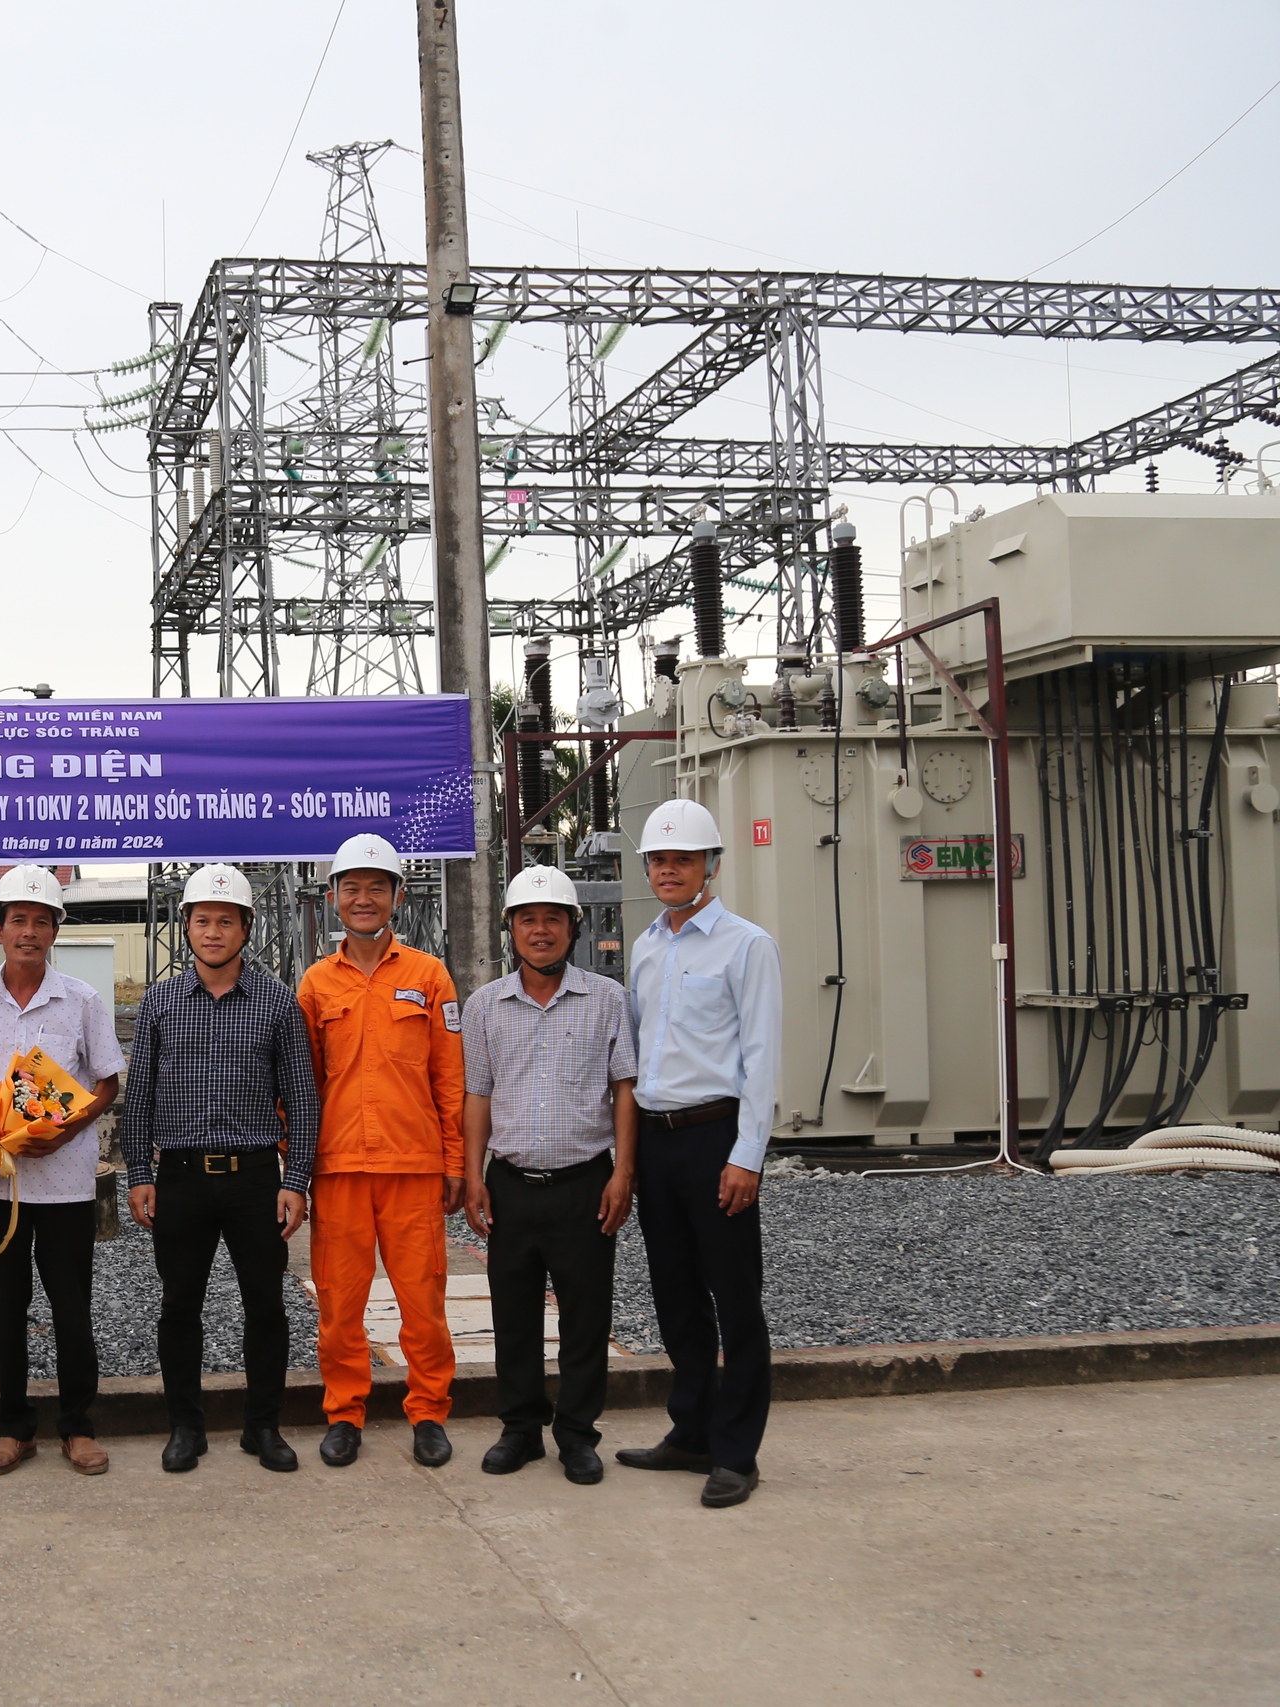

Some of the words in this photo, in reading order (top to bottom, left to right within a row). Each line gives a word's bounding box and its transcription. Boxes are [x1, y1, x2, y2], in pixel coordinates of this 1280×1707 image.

[509, 493, 525, 501] C11
[24, 710, 61, 724] LỰC
[66, 708, 115, 722] MIỀN
[120, 711, 163, 721] NAM
[35, 725, 73, 738] SÓC
[78, 725, 140, 738] TRĂNG
[50, 749, 162, 783] ĐIỆN
[14, 794, 72, 821] 110KV
[77, 794, 89, 821] 2
[94, 794, 149, 826] MẠCH
[154, 788, 191, 820] SÓC
[195, 787, 257, 820] TRĂNG
[261, 793, 273, 819] 2
[290, 787, 327, 819] SÓC
[331, 786, 391, 818] TRĂNG
[756, 826, 767, 840] T1
[2, 836, 50, 851] tháng
[55, 836, 76, 850] 10
[80, 835, 118, 850] năm
[121, 835, 164, 849] 2024
